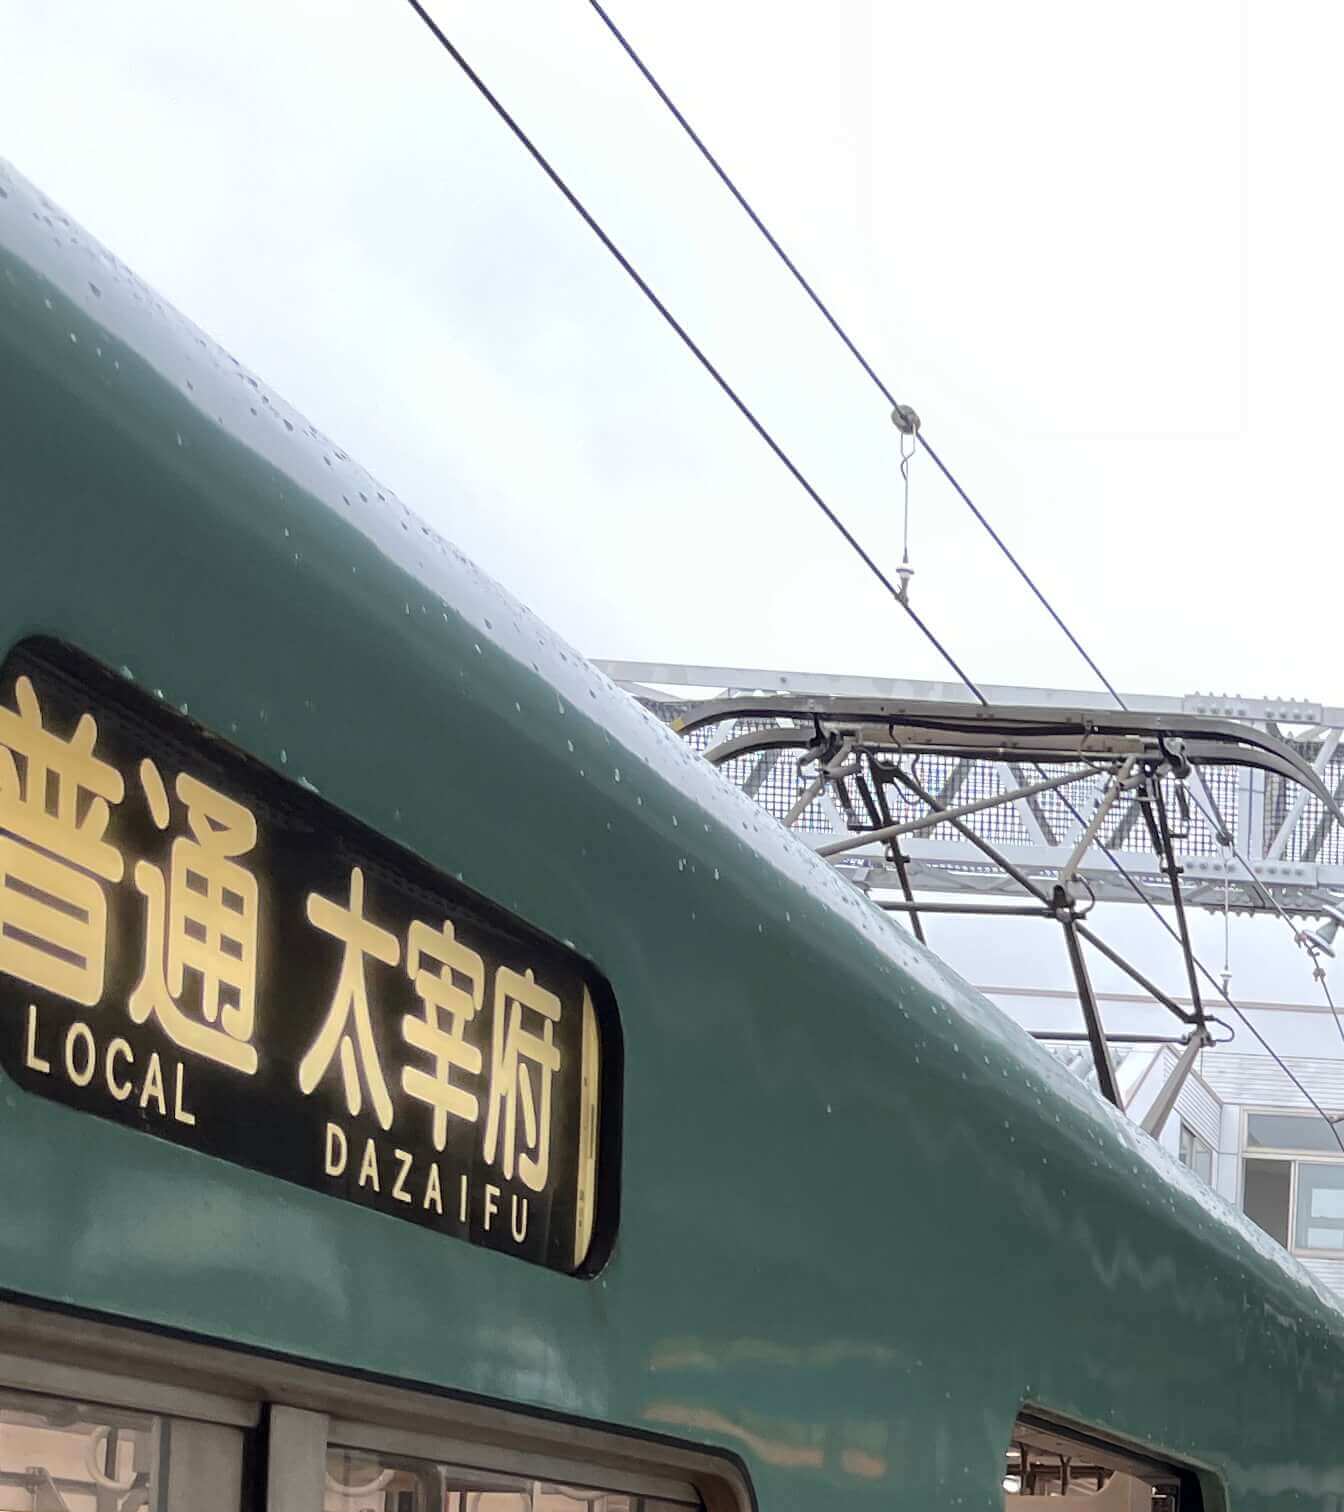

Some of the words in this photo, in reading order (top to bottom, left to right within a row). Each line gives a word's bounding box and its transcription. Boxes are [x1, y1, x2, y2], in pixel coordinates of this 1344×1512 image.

[0, 676, 258, 1075] 普通
[299, 866, 562, 1192] 太宰府
[24, 1004, 196, 1125] LOCAL
[325, 1122, 528, 1242] DAZAIFU
